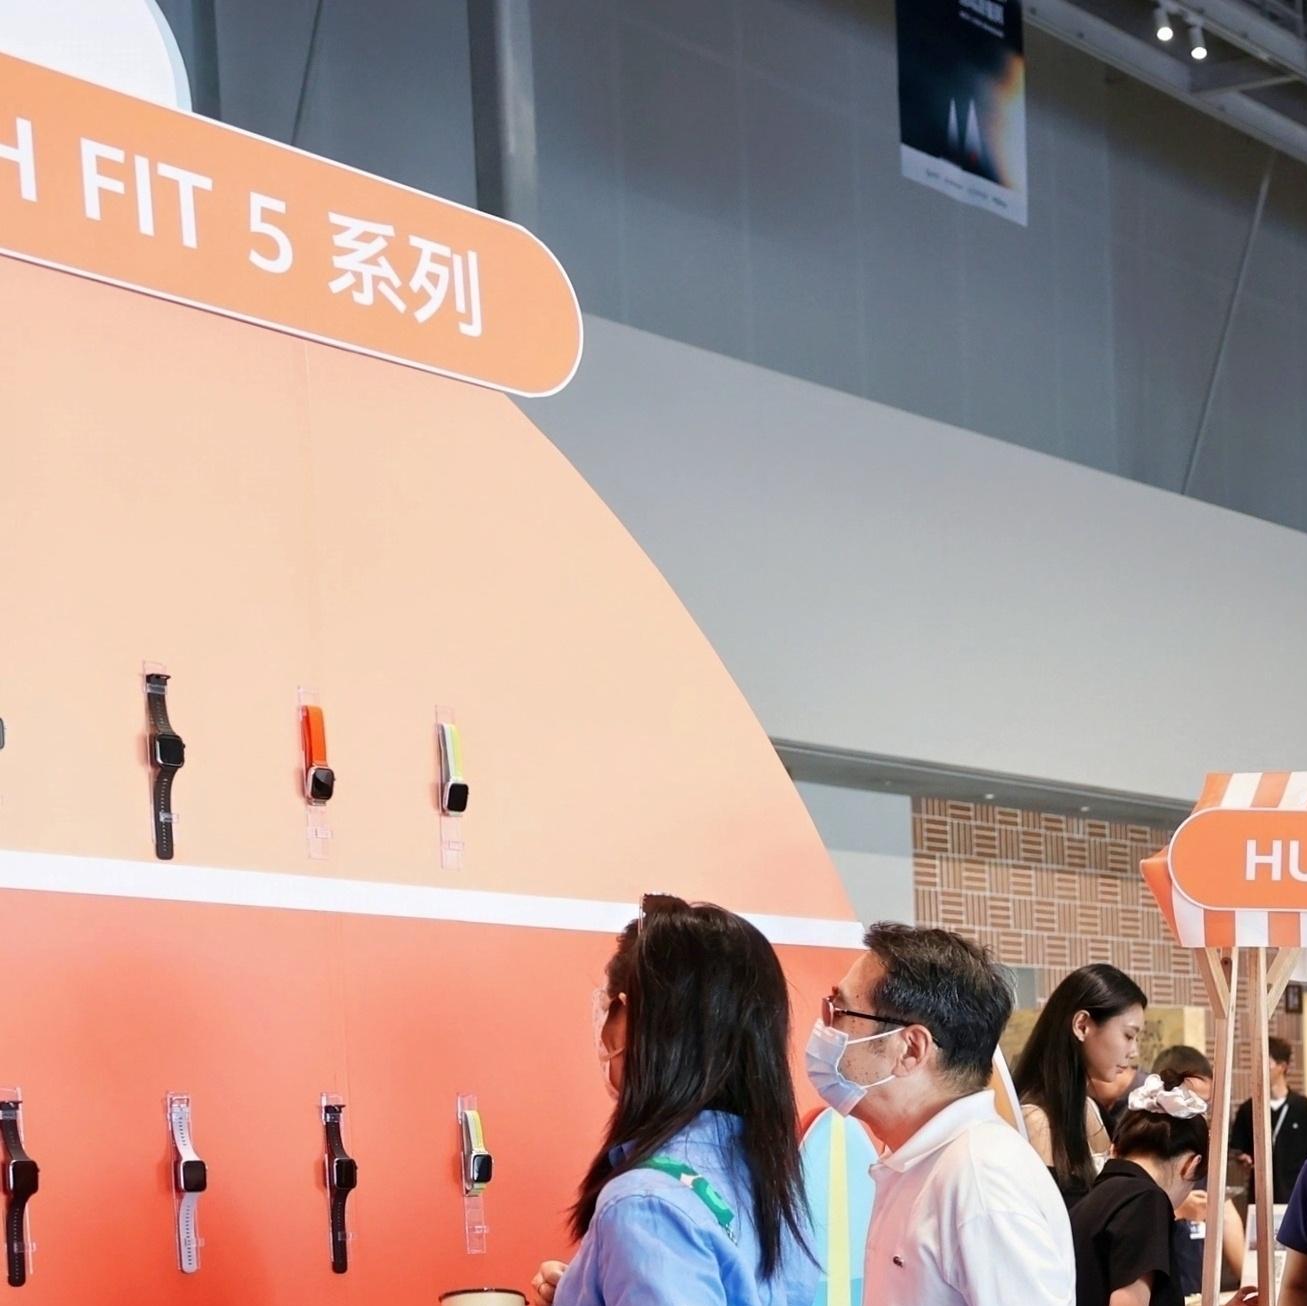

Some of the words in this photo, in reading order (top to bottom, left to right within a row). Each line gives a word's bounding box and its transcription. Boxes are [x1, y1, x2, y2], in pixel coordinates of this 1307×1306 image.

[80, 137, 213, 250] FIT
[248, 191, 294, 274] 5
[327, 211, 483, 338] 系列
